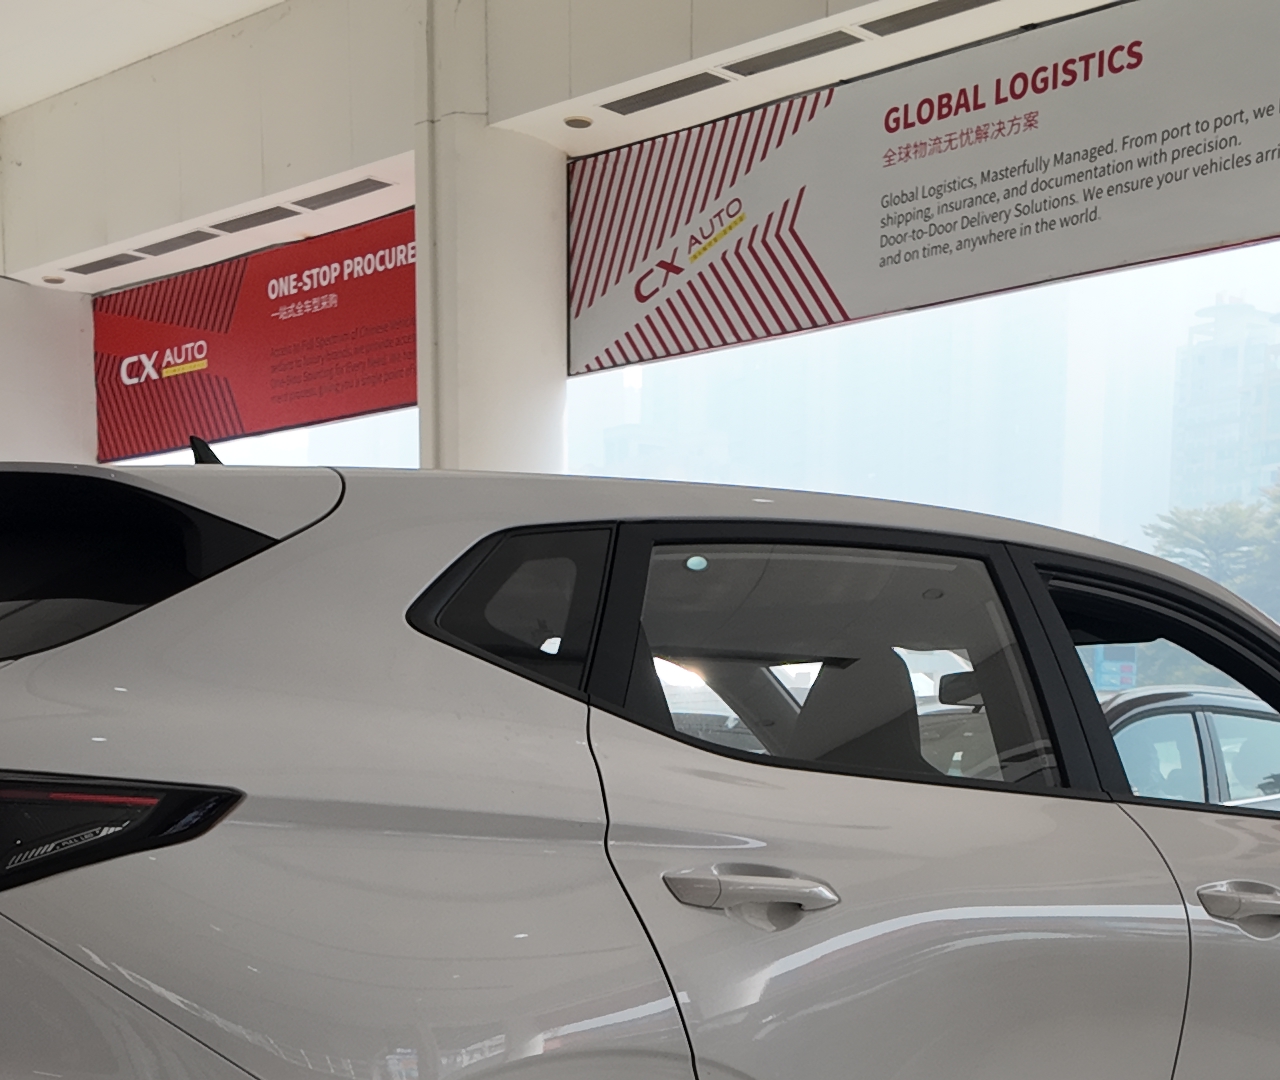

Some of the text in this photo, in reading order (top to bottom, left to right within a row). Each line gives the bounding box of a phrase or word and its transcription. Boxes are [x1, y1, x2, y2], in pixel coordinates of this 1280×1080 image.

[883, 40, 1144, 134] GLOBAL LOGISTICS
[881, 186, 919, 209] Global
[921, 175, 978, 200] Logistics,
[980, 155, 1051, 185] Masterfully
[1053, 138, 1118, 168] Managed.
[1121, 133, 1158, 152] From
[1161, 121, 1192, 145] port
[1194, 118, 1210, 134] to
[1213, 108, 1250, 133] port,
[1252, 103, 1275, 120] we
[882, 110, 1040, 169] 全球物流无忧解决方案
[879, 219, 958, 249] Door-to-Door
[960, 207, 1012, 231] Delivery
[1014, 192, 1079, 218] Solutions.
[1082, 186, 1104, 203] We
[1106, 175, 1154, 197] ensure
[1156, 167, 1190, 191] your
[1192, 153, 1253, 178] vehicles
[880, 135, 1243, 229] shipping, insurance, and documentation with precision.
[687, 197, 743, 256] AUTO
[879, 205, 1102, 269] and on time, anywhere in the world.
[267, 240, 417, 301] ONE-STOP PROCURE
[634, 246, 686, 304] CX
[120, 349, 160, 386] CX
[161, 340, 208, 369] AUTO
